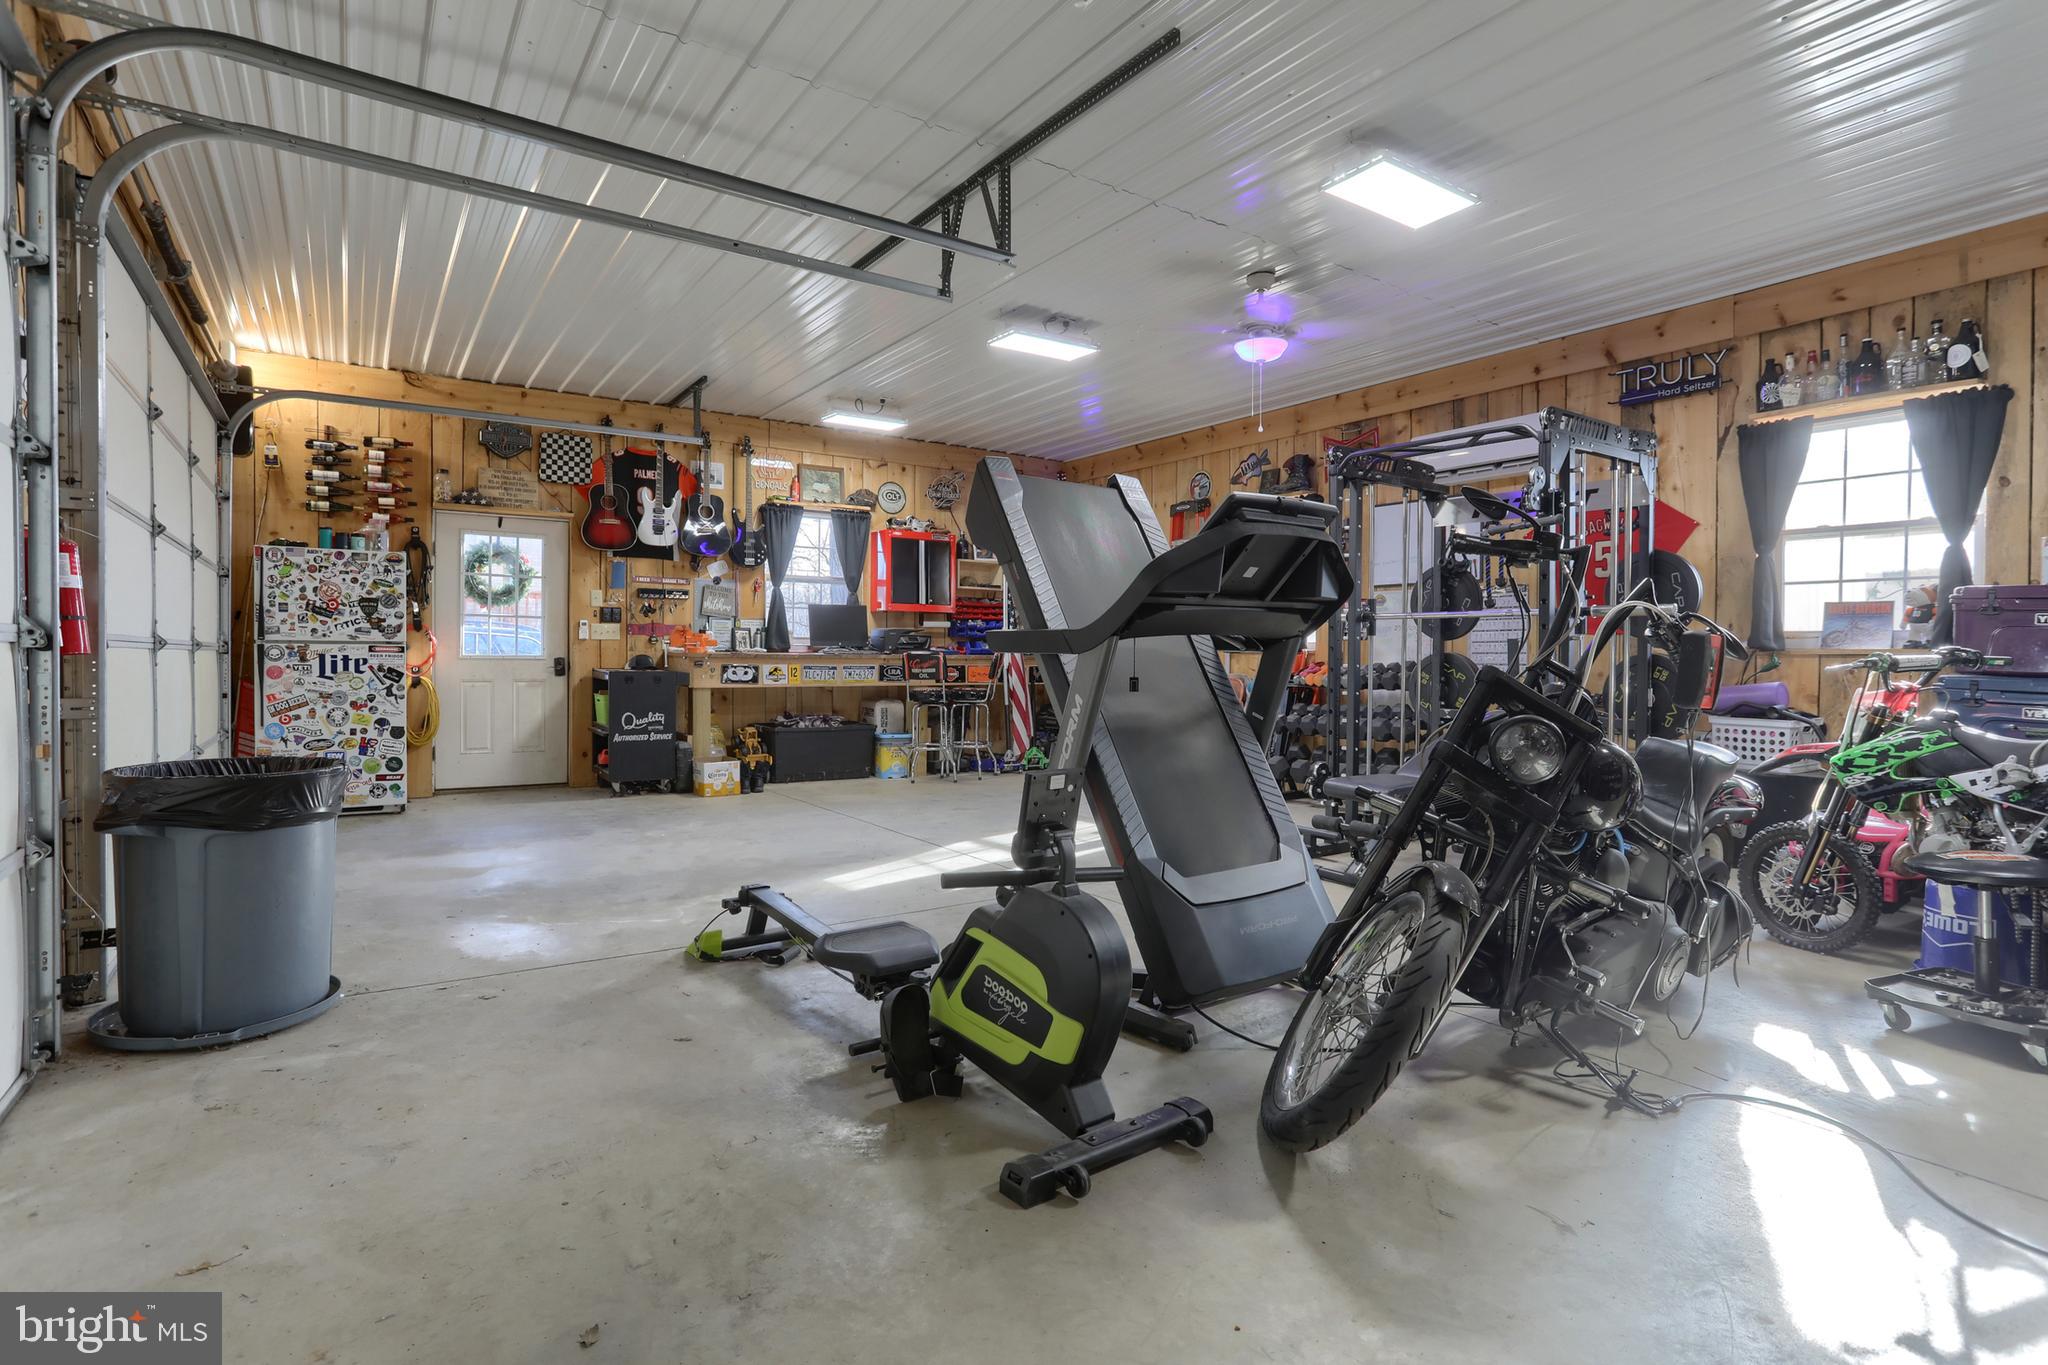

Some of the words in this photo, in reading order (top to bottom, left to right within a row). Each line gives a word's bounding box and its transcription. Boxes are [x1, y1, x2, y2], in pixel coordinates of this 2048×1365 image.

[1616, 348, 1728, 393] TRULY
[1657, 385, 1681, 397] Hard
[1684, 380, 1716, 393] Seltzer
[633, 468, 657, 480] PALME
[1670, 571, 1686, 608] CAP
[334, 617, 361, 631] RTIC
[317, 653, 368, 681] Lite
[621, 711, 665, 730] Quality
[613, 733, 649, 743] AUTHORIZED
[649, 732, 673, 741] SERVICE
